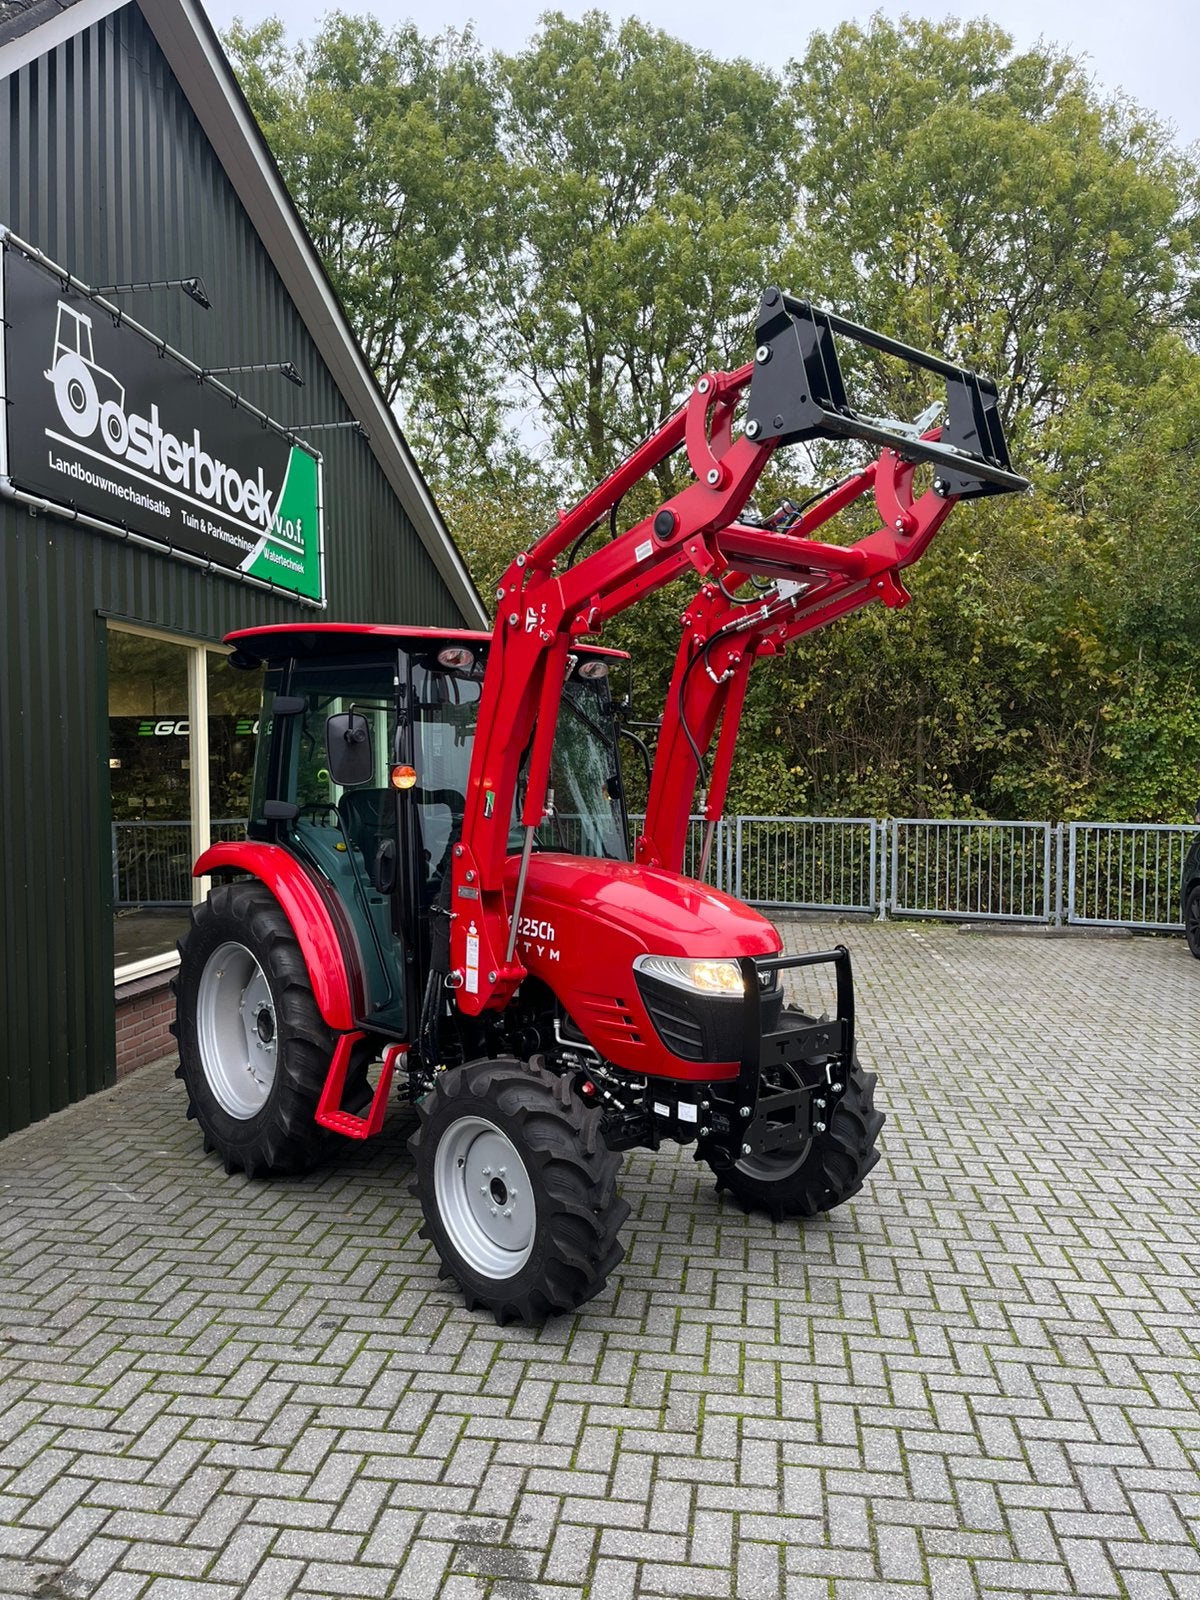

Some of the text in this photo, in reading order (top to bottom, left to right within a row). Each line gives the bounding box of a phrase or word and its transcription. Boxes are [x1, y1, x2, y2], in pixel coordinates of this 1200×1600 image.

[49, 451, 305, 575] Landbouwmechanisatie Tuin & Parkmachines Watertechniek
[274, 514, 305, 546] v.o.f.
[523, 941, 560, 962] TYM
